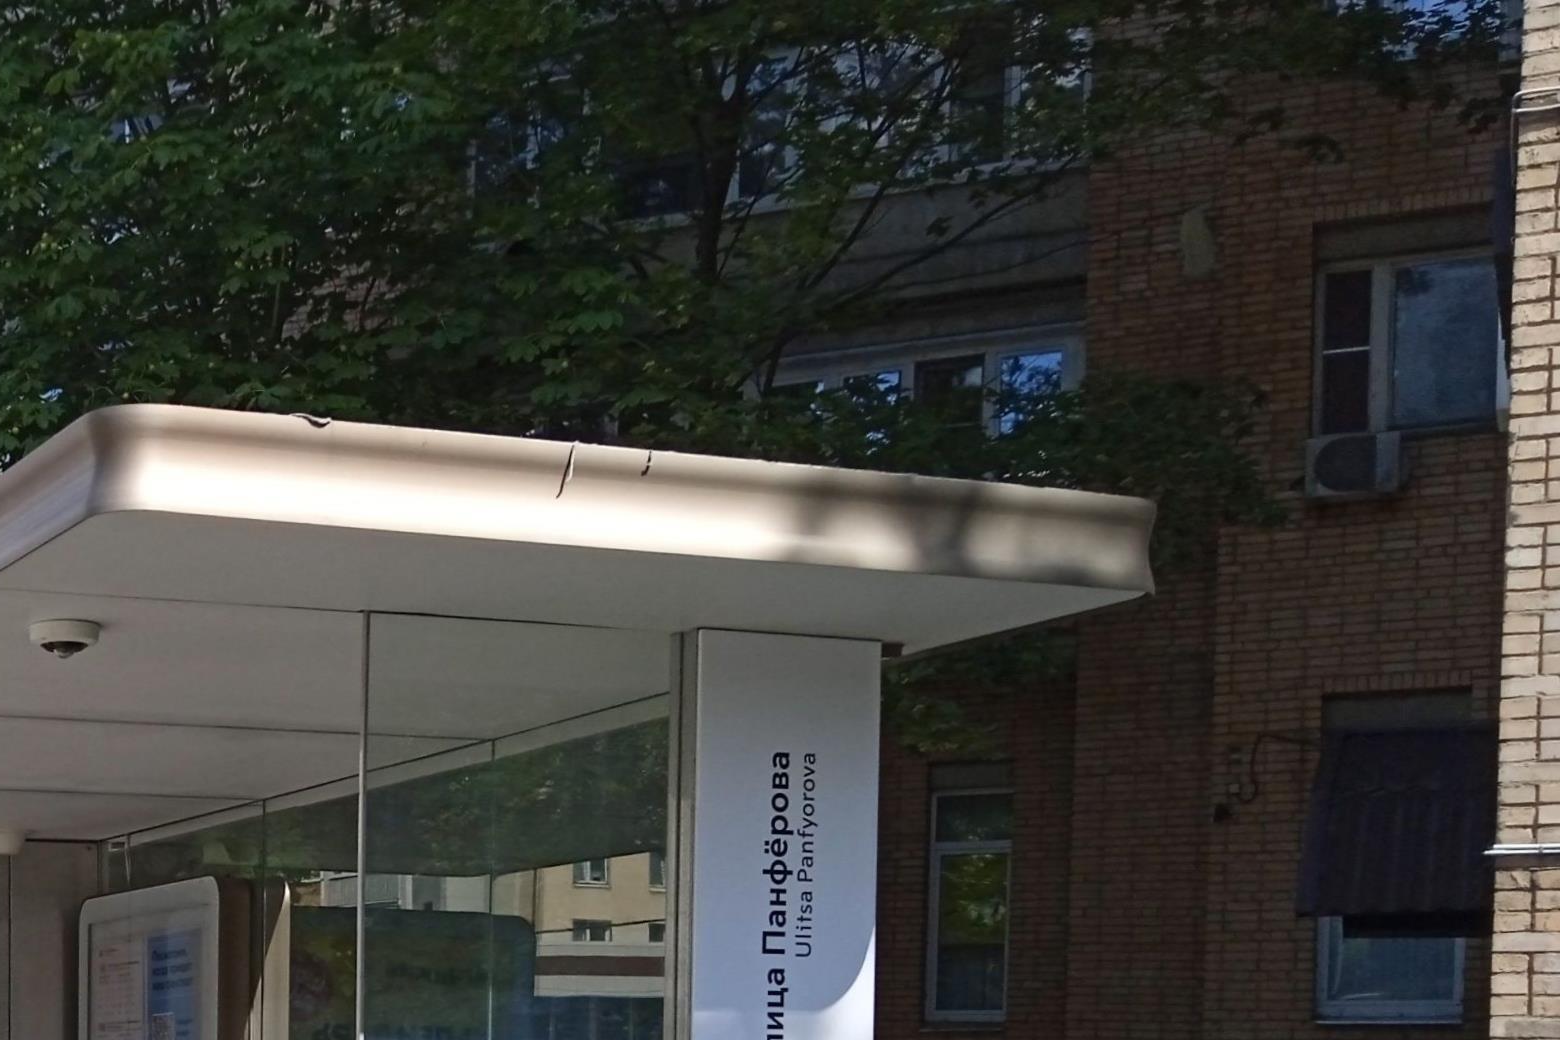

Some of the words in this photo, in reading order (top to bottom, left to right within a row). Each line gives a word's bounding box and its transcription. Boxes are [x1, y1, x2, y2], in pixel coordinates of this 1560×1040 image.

[762, 752, 793, 955] Панфёрова
[797, 753, 817, 882] Panfyorova
[795, 891, 813, 957] Ulitsa
